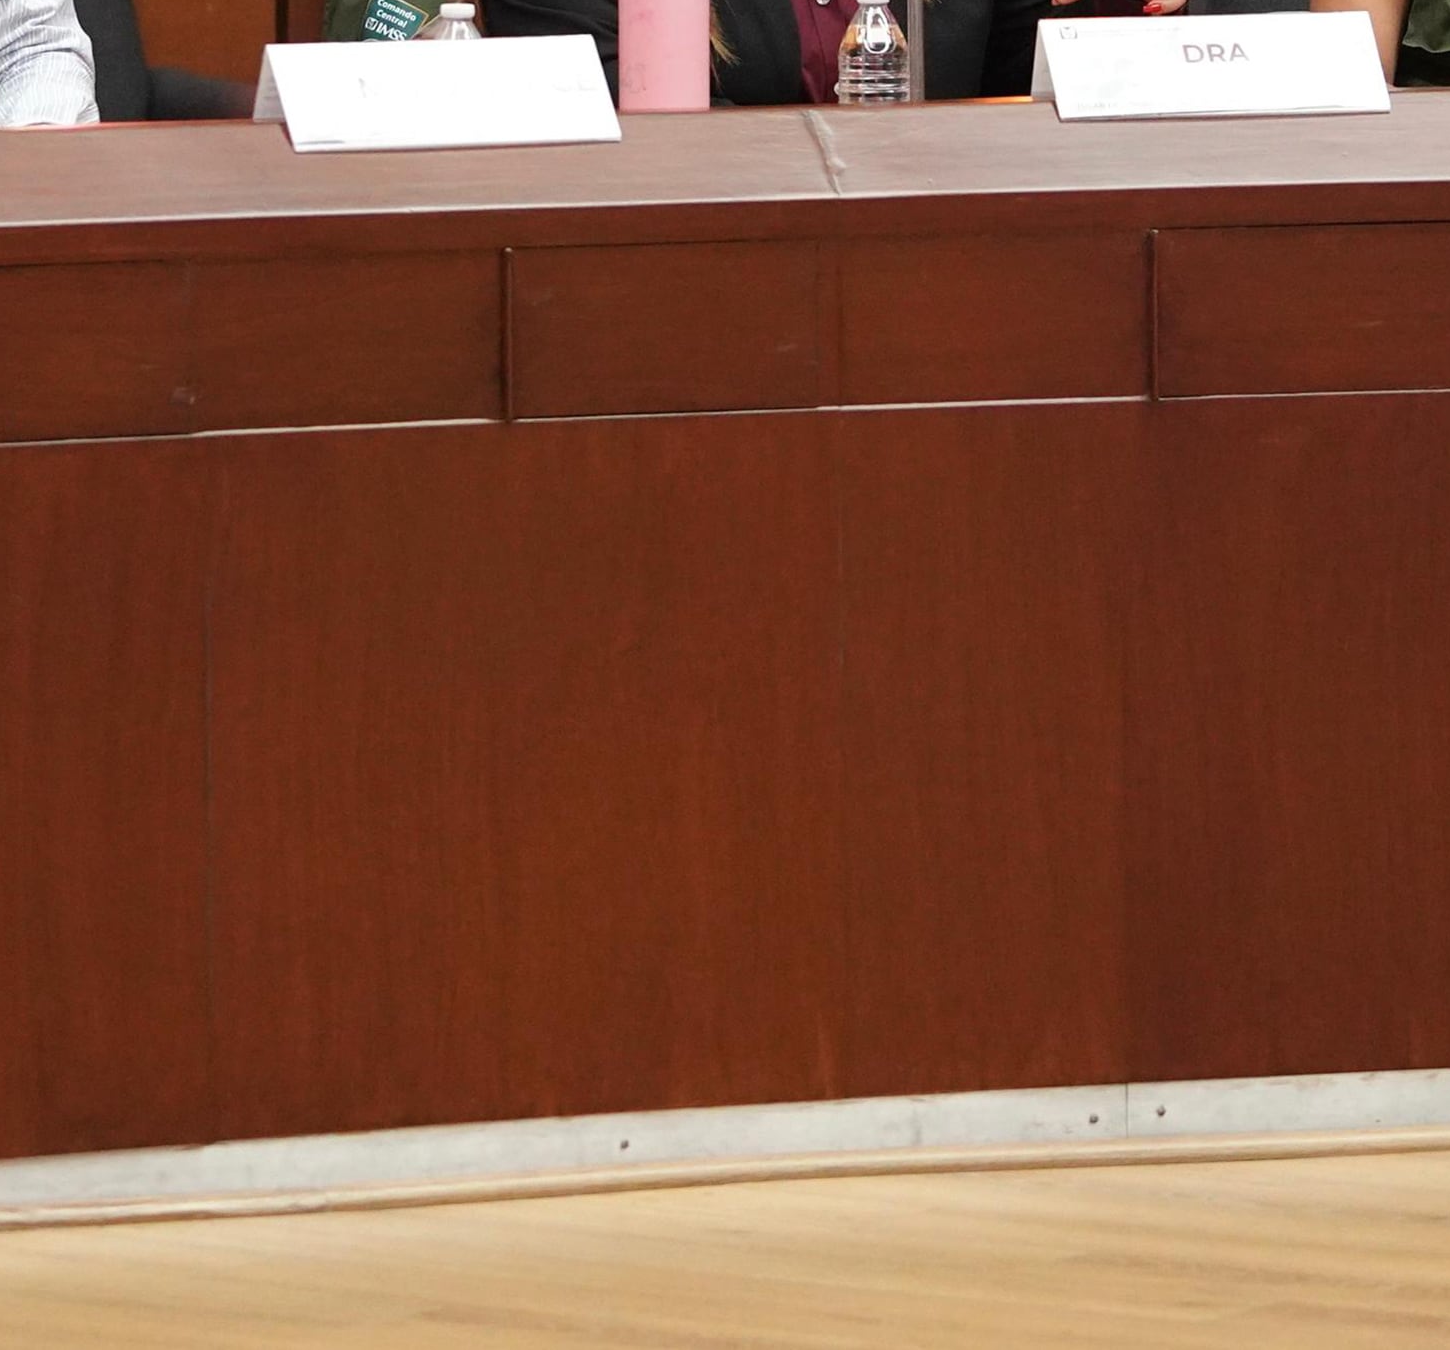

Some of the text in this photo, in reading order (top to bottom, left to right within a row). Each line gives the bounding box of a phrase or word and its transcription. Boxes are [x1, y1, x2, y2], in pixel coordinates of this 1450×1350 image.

[376, 9, 408, 28] Central
[375, 22, 407, 41] IMSS
[1182, 44, 1249, 64] DRA
